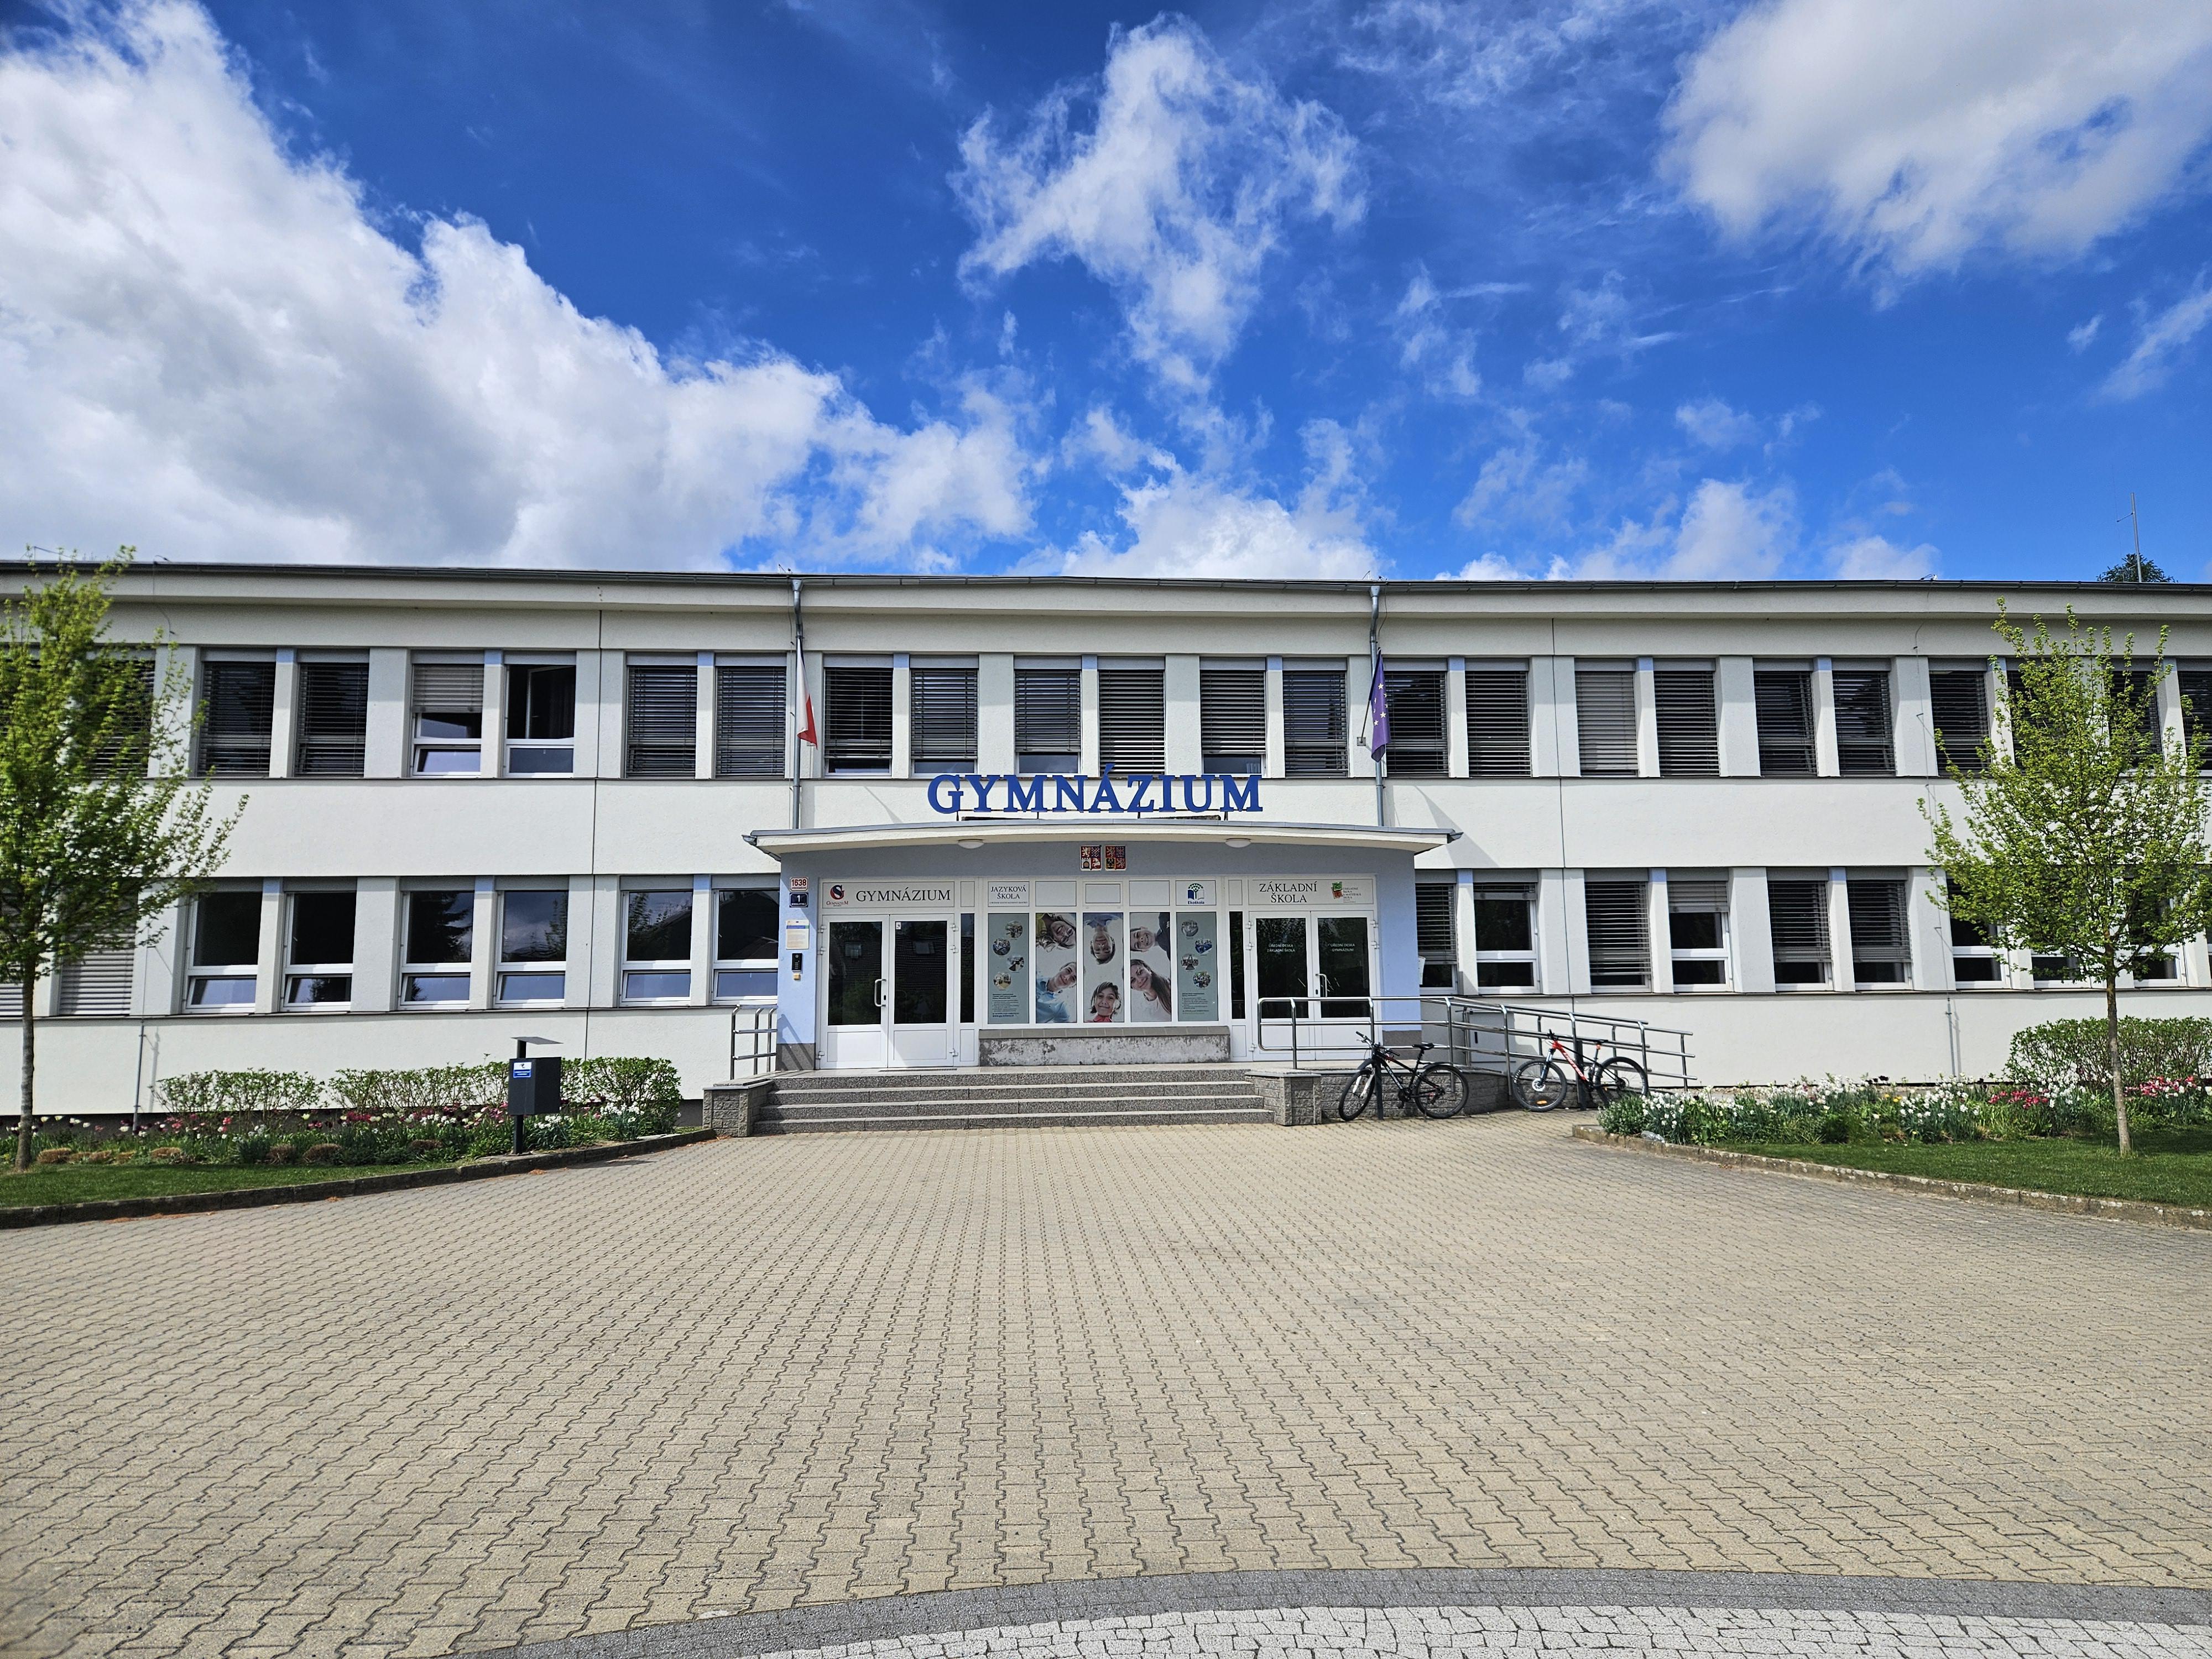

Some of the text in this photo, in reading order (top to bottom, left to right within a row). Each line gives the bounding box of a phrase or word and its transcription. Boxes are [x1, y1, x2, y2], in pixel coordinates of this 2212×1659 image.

[927, 763, 1263, 813] GYMNÁZIUM
[1259, 881, 1317, 892] ZÁKLADNÍ
[856, 887, 951, 901] GYMNÁZIUM
[1271, 892, 1307, 903] ŠKOLA
